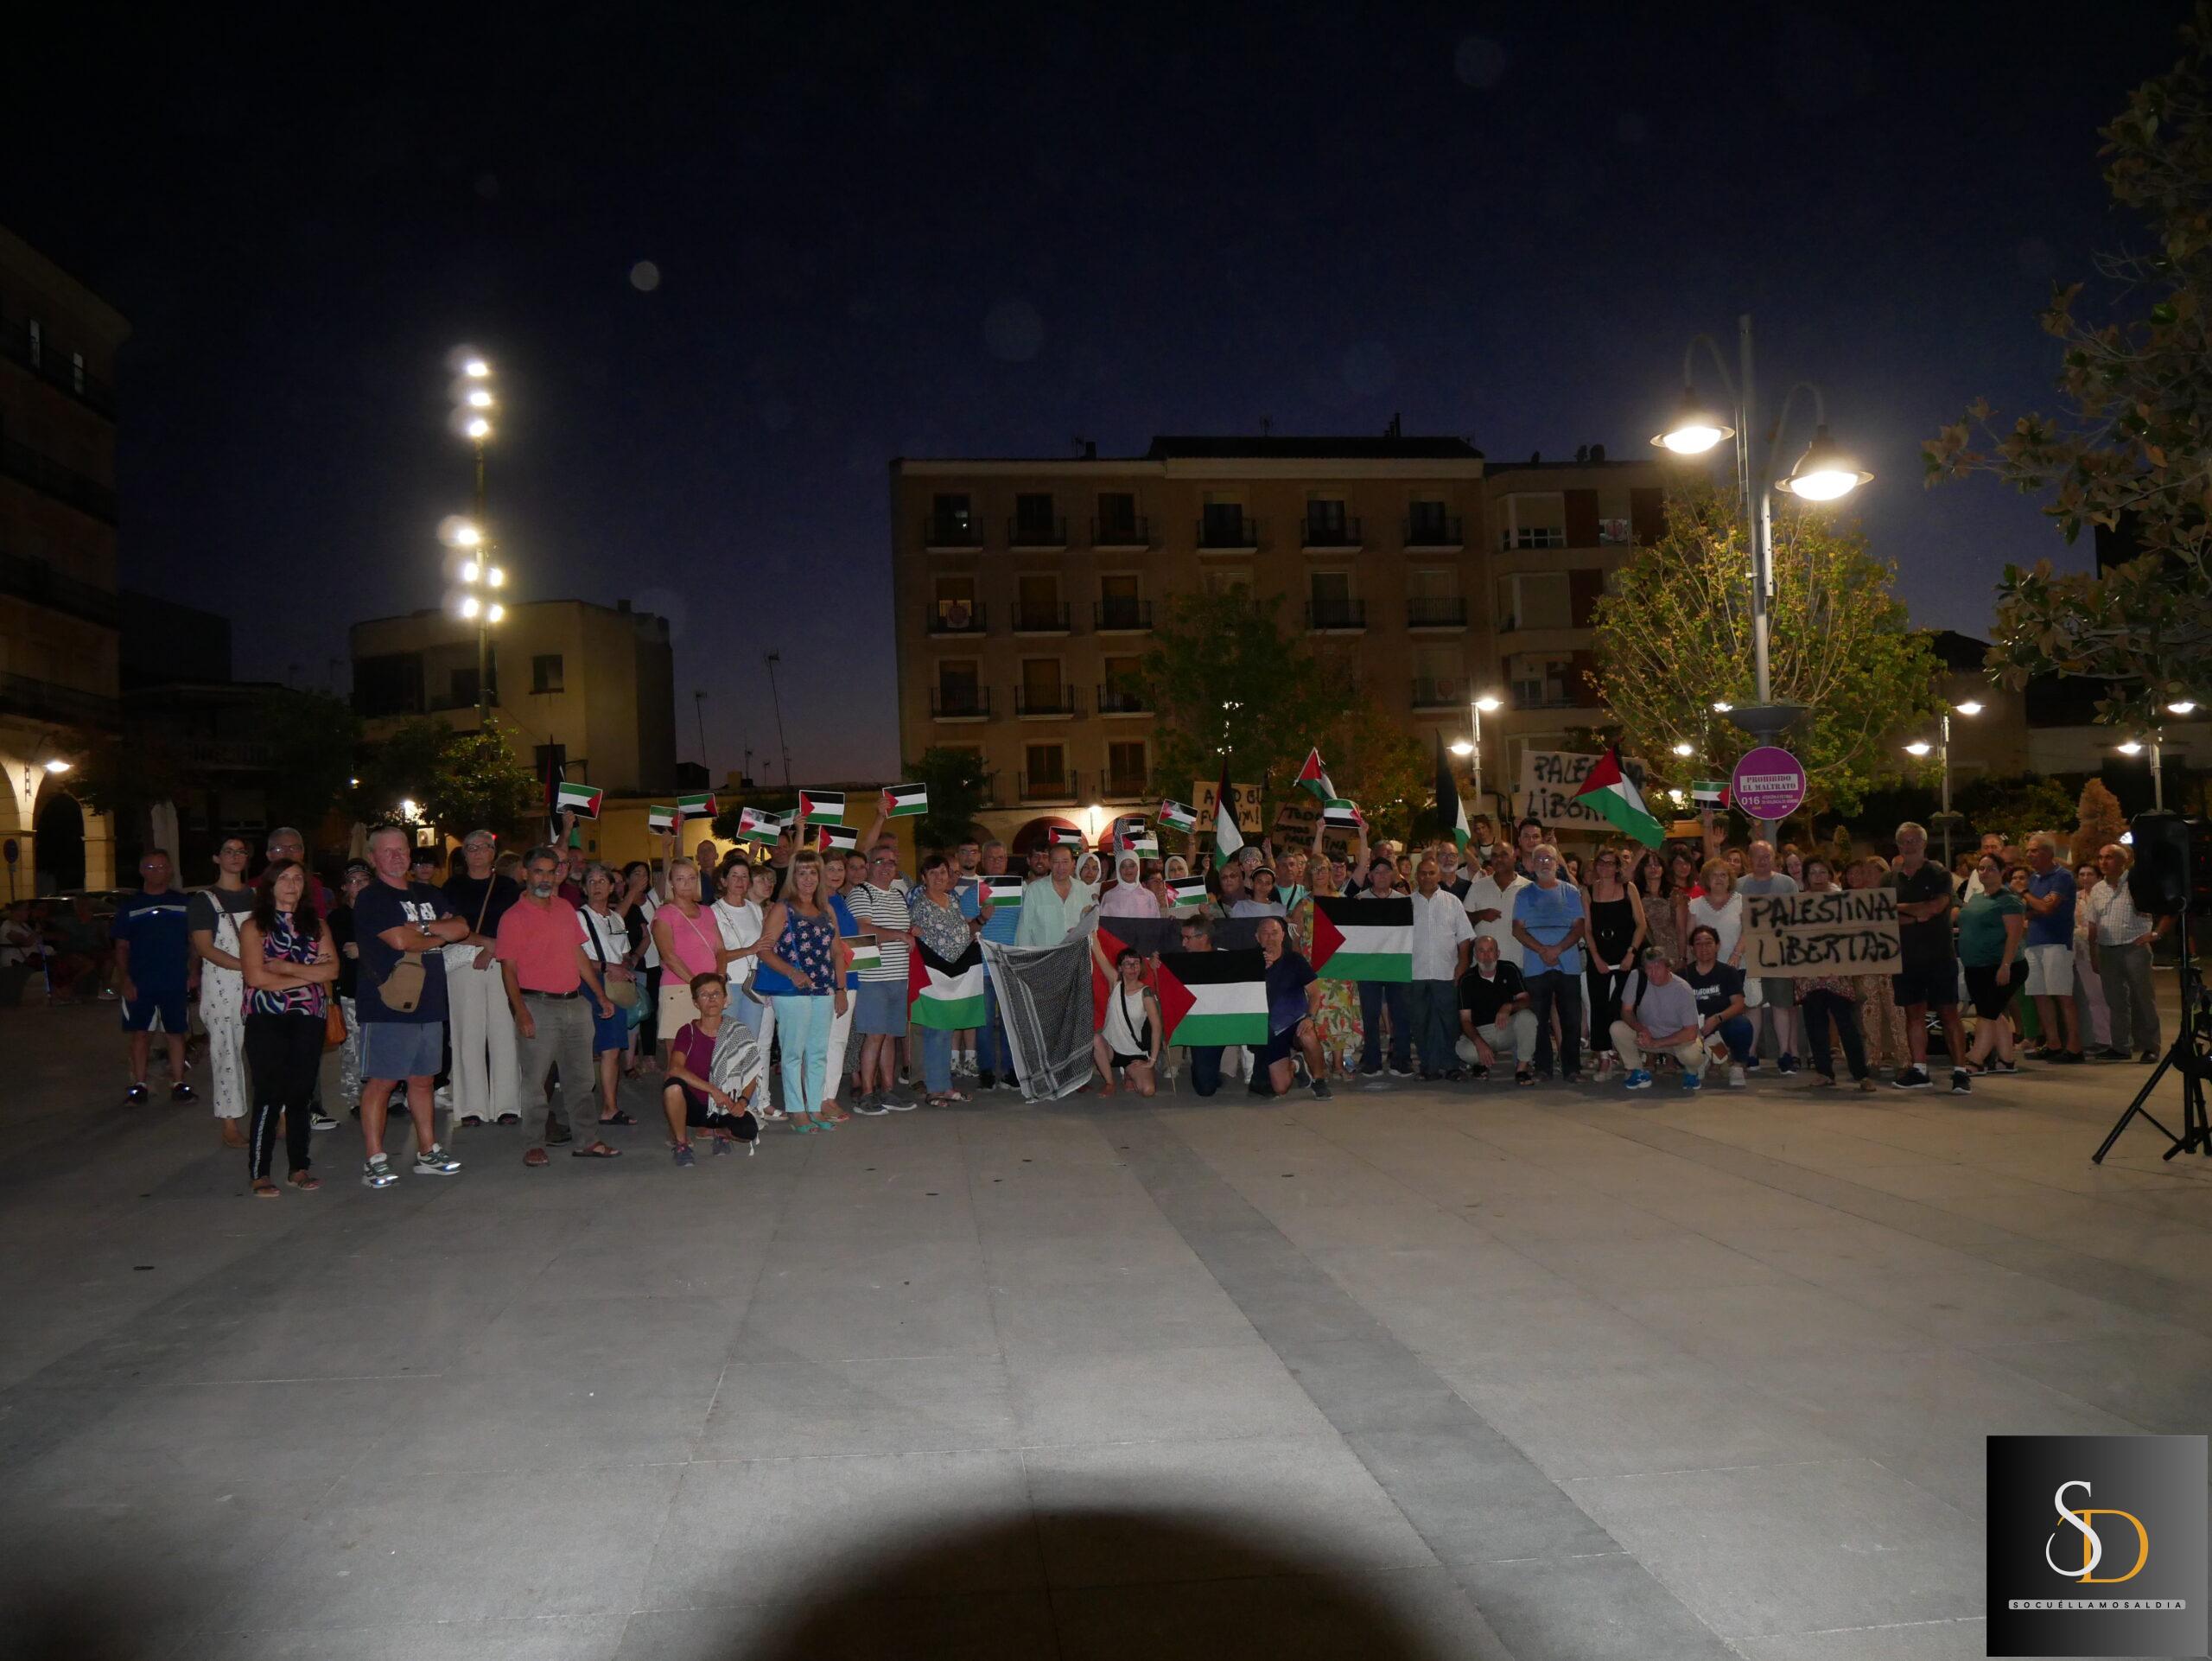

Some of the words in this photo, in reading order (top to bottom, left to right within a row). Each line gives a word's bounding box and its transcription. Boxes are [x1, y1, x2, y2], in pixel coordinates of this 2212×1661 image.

[1755, 783, 1796, 792] MALTRATO
[1741, 796, 1760, 805] 016
[1748, 892, 1897, 928] PALESTINA
